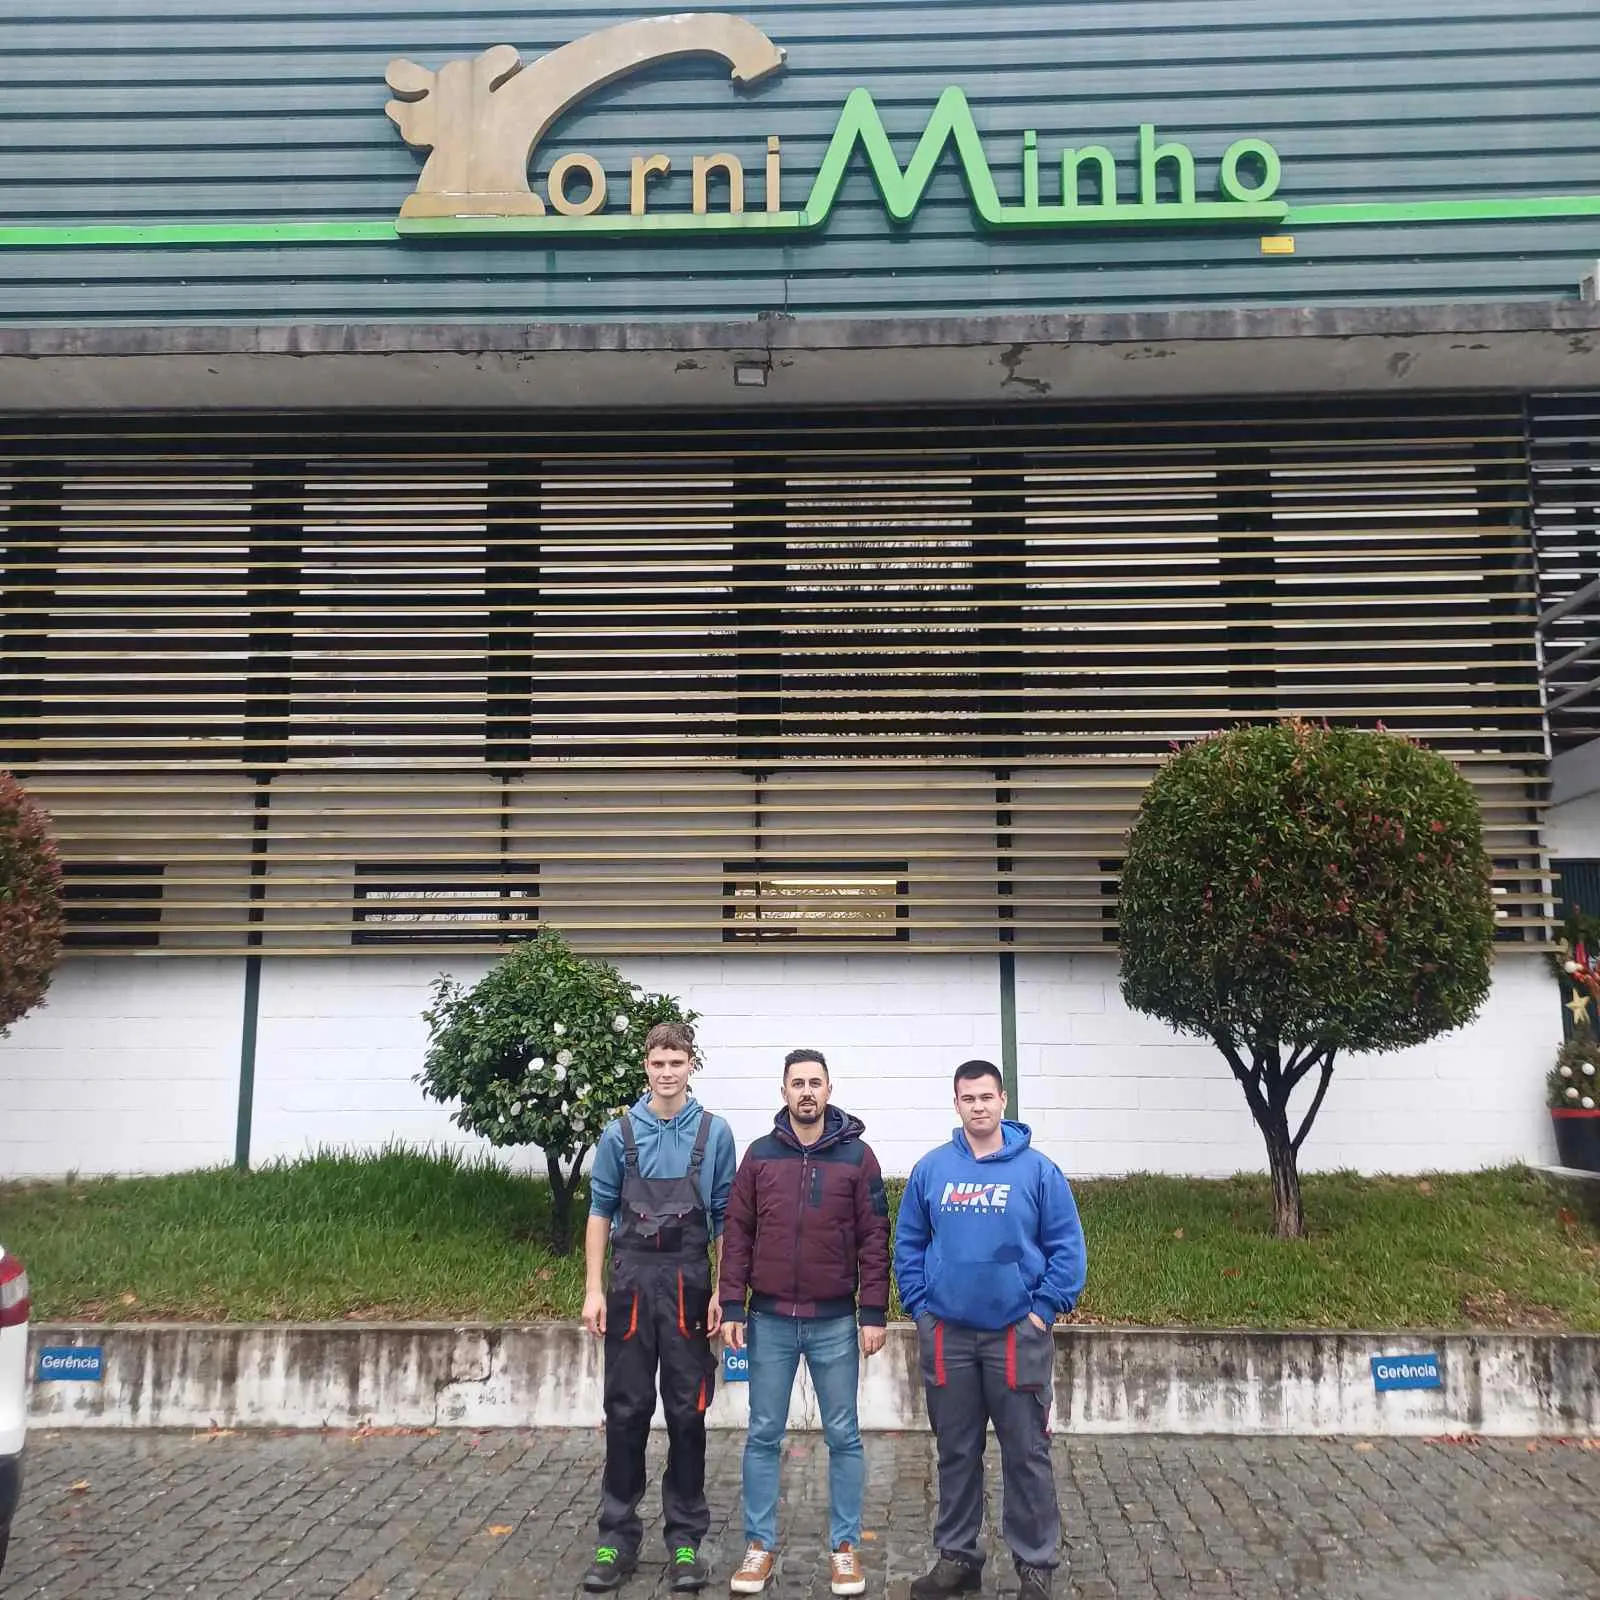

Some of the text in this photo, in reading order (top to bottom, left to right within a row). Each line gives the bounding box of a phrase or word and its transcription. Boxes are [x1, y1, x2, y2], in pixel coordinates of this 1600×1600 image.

[941, 1182, 1010, 1207] NIKE
[42, 1355, 99, 1368] Gerência
[1377, 1363, 1437, 1379] Gerência
